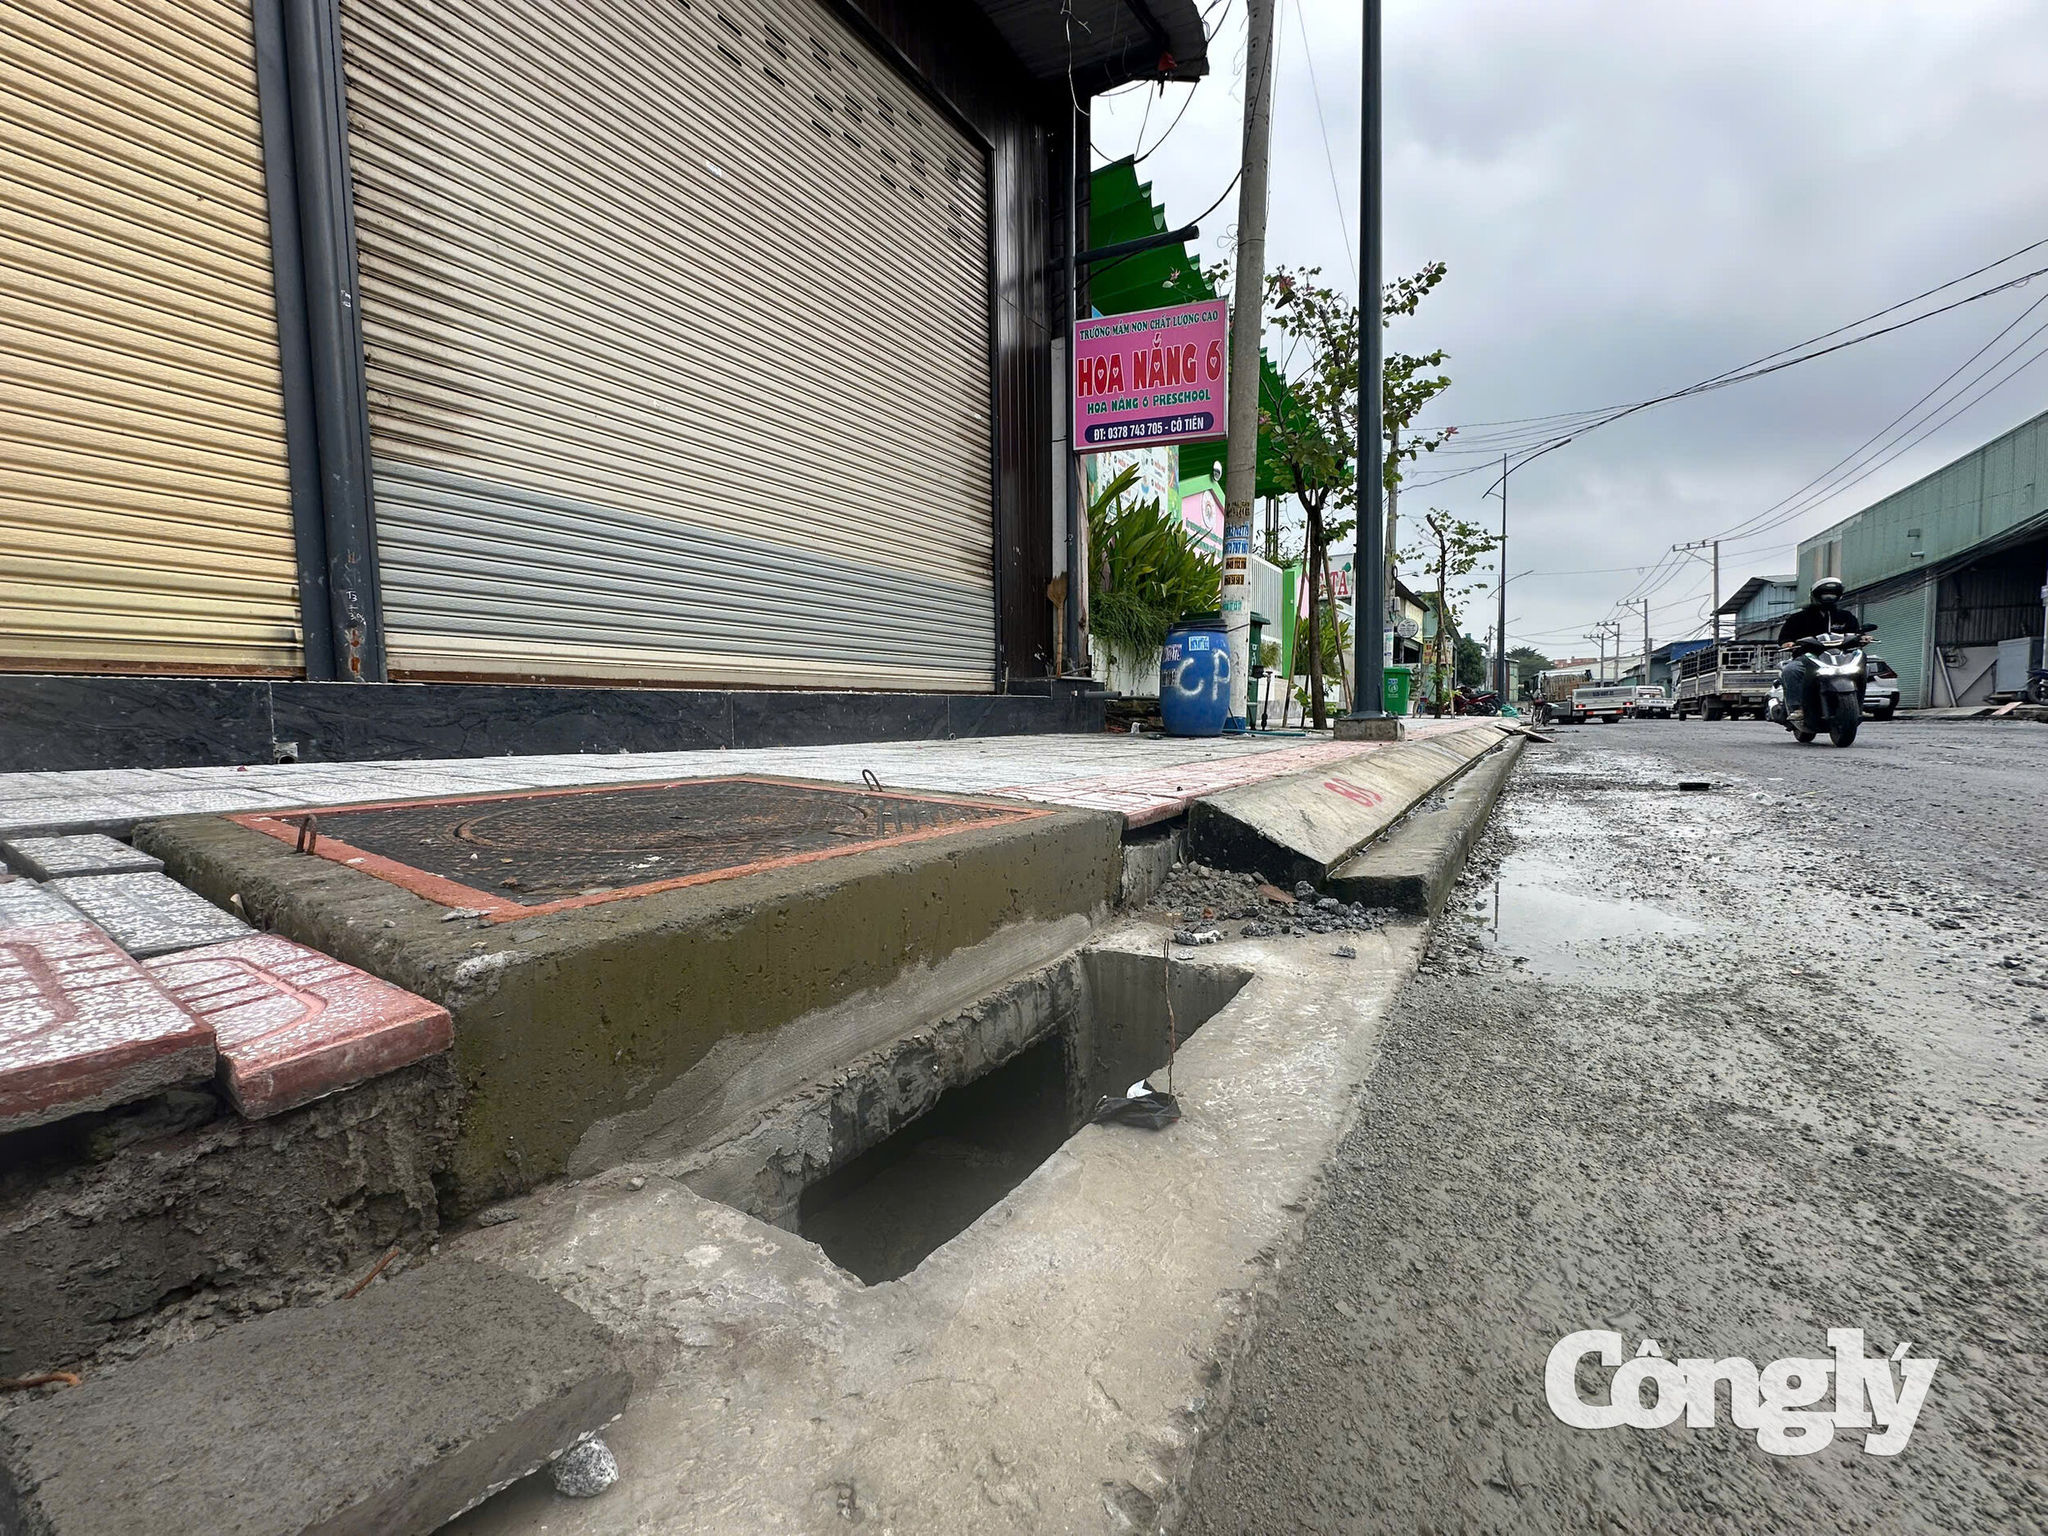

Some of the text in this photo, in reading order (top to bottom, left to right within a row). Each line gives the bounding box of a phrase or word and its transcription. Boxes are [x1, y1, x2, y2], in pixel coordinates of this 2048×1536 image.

[1132, 321, 1148, 334] NON
[1202, 310, 1219, 322] CAO
[1078, 333, 1222, 398] HOA NẮNG 6
[1087, 402, 1108, 415] HOA
[1142, 396, 1149, 409] 6
[1153, 389, 1211, 406] PRESCHOOL
[1108, 426, 1128, 440] 0378
[1130, 424, 1145, 437] 743
[1147, 422, 1163, 435] 705
